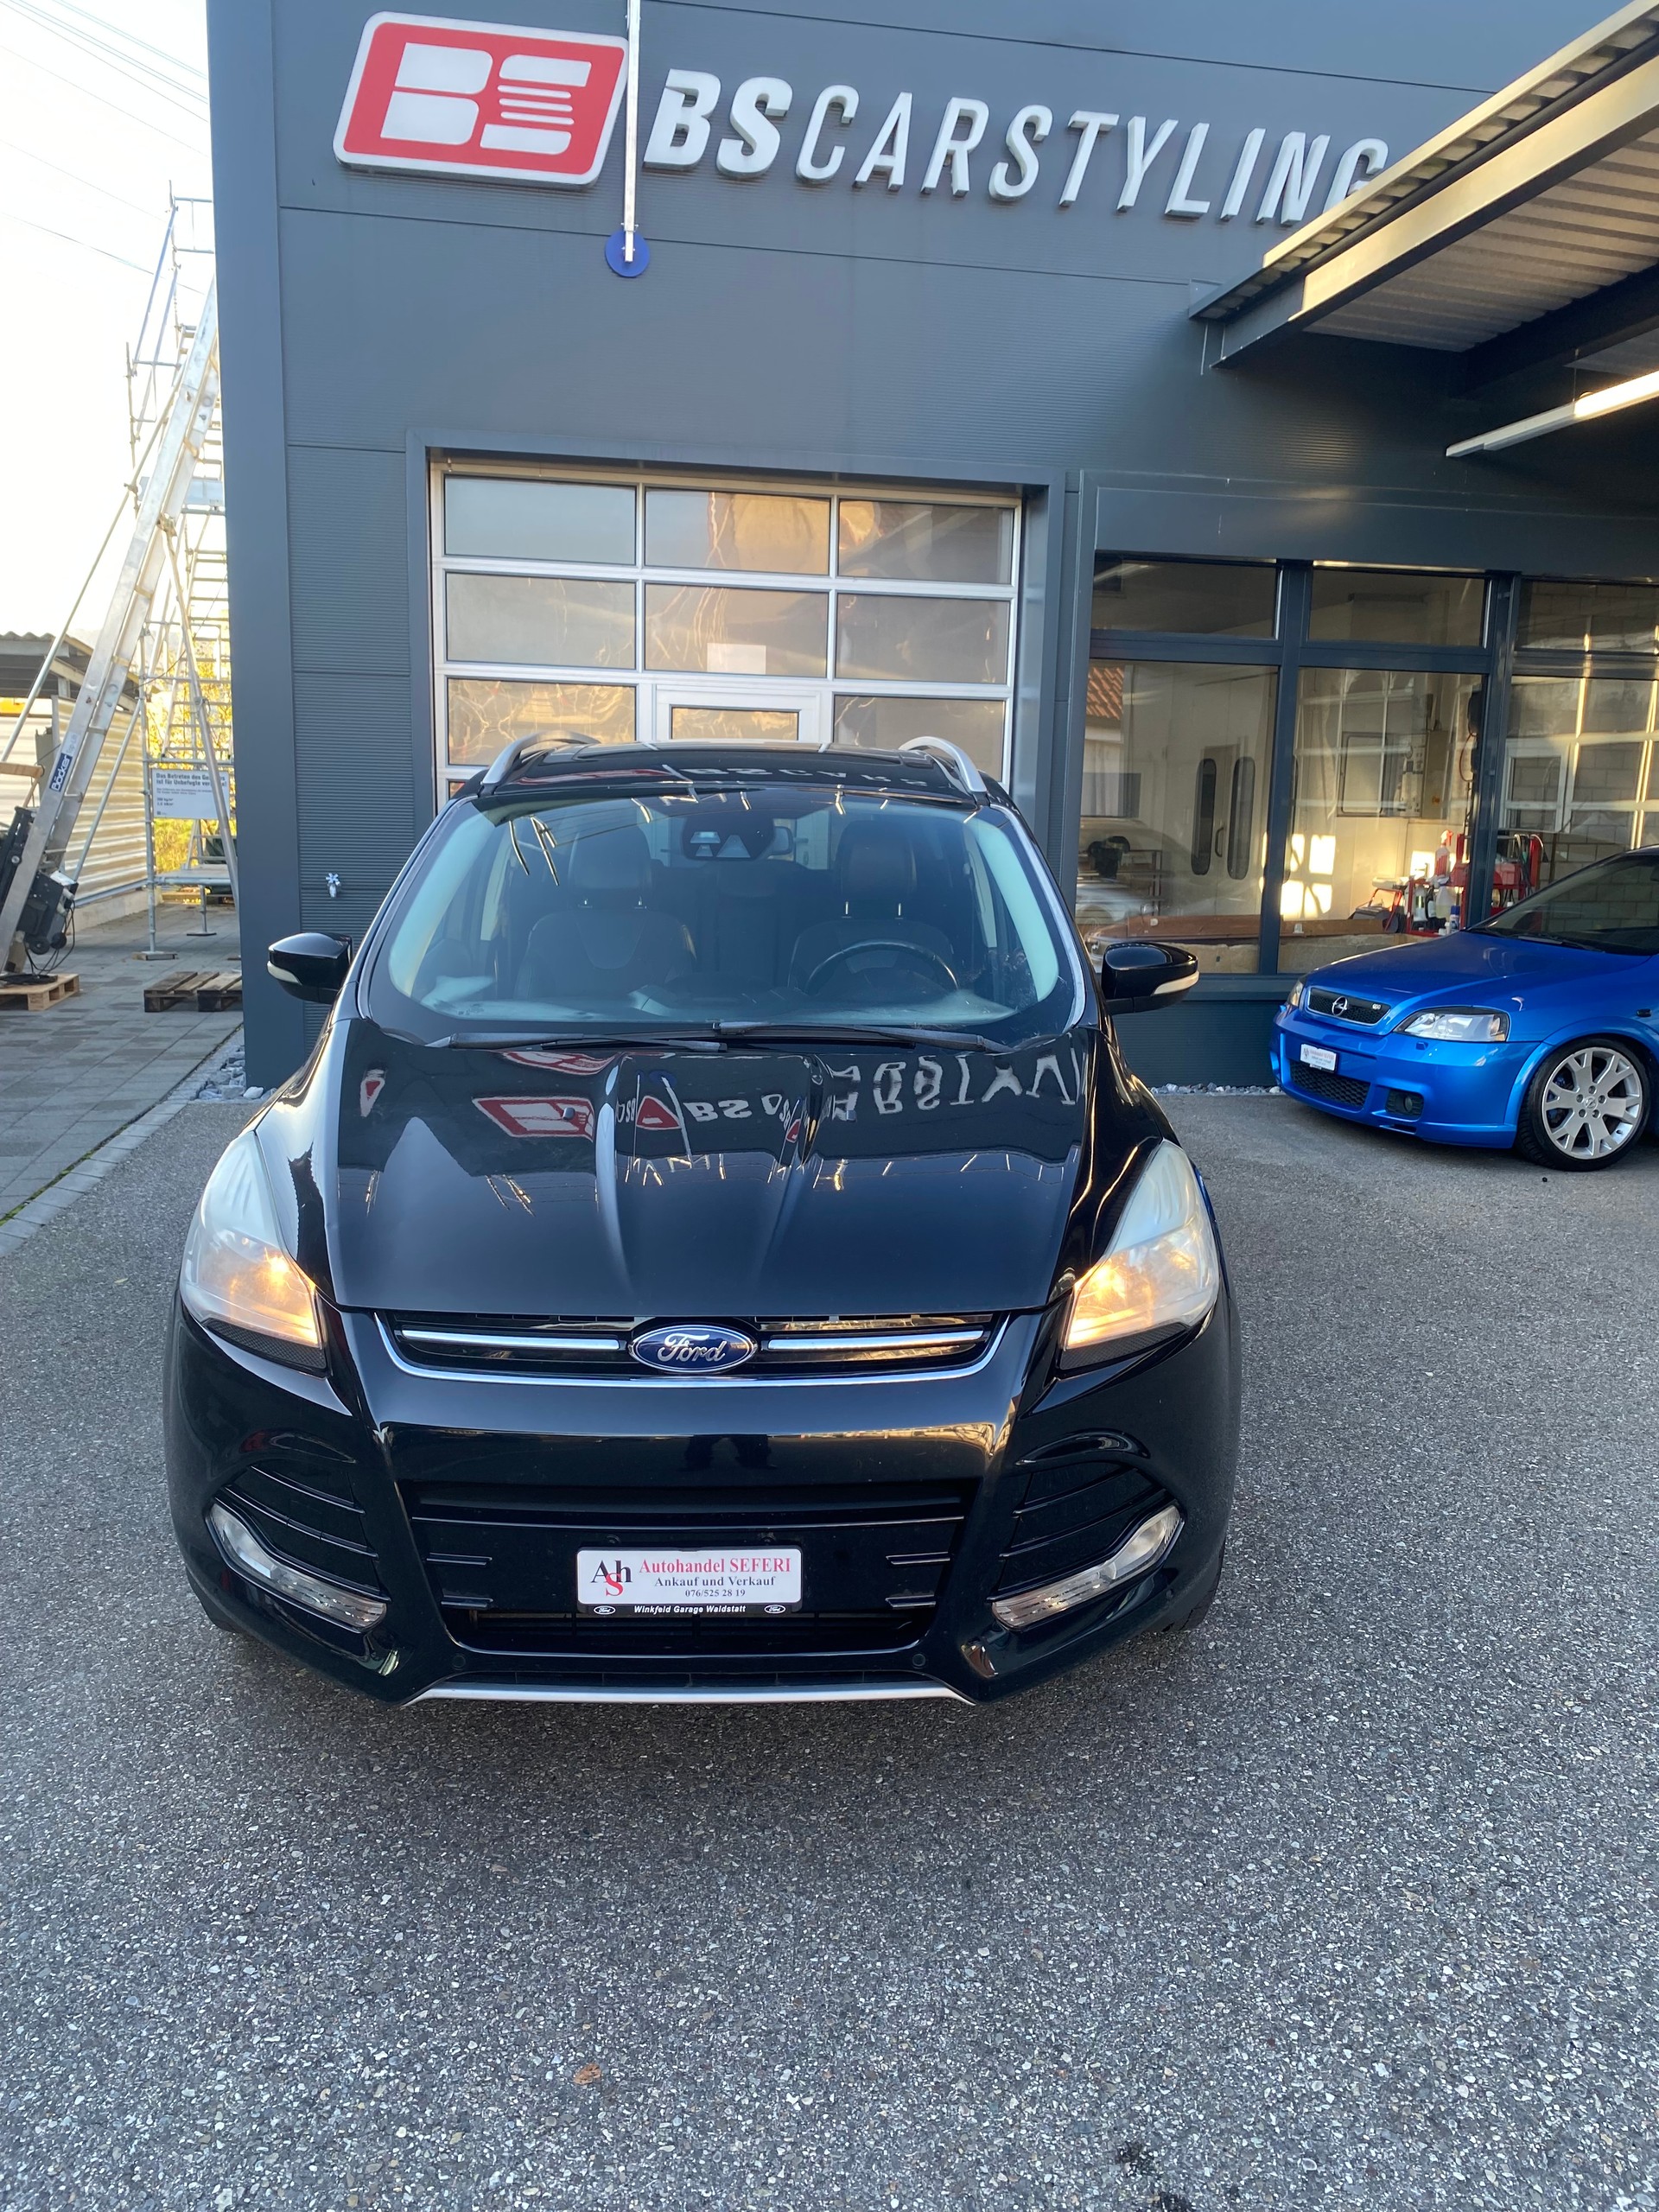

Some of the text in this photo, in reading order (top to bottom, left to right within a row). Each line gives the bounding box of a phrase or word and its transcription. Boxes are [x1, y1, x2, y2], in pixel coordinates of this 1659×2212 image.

[51, 754, 71, 791] Böcker
[658, 1332, 728, 1363] Ford
[639, 1557, 791, 1573] Autohandel SEFERI
[654, 1576, 776, 1587] Ankauf und Verkauf
[684, 1588, 746, 1597] 076/525 28 19
[633, 1605, 746, 1614] Winkfeld Garage Waldstatt
